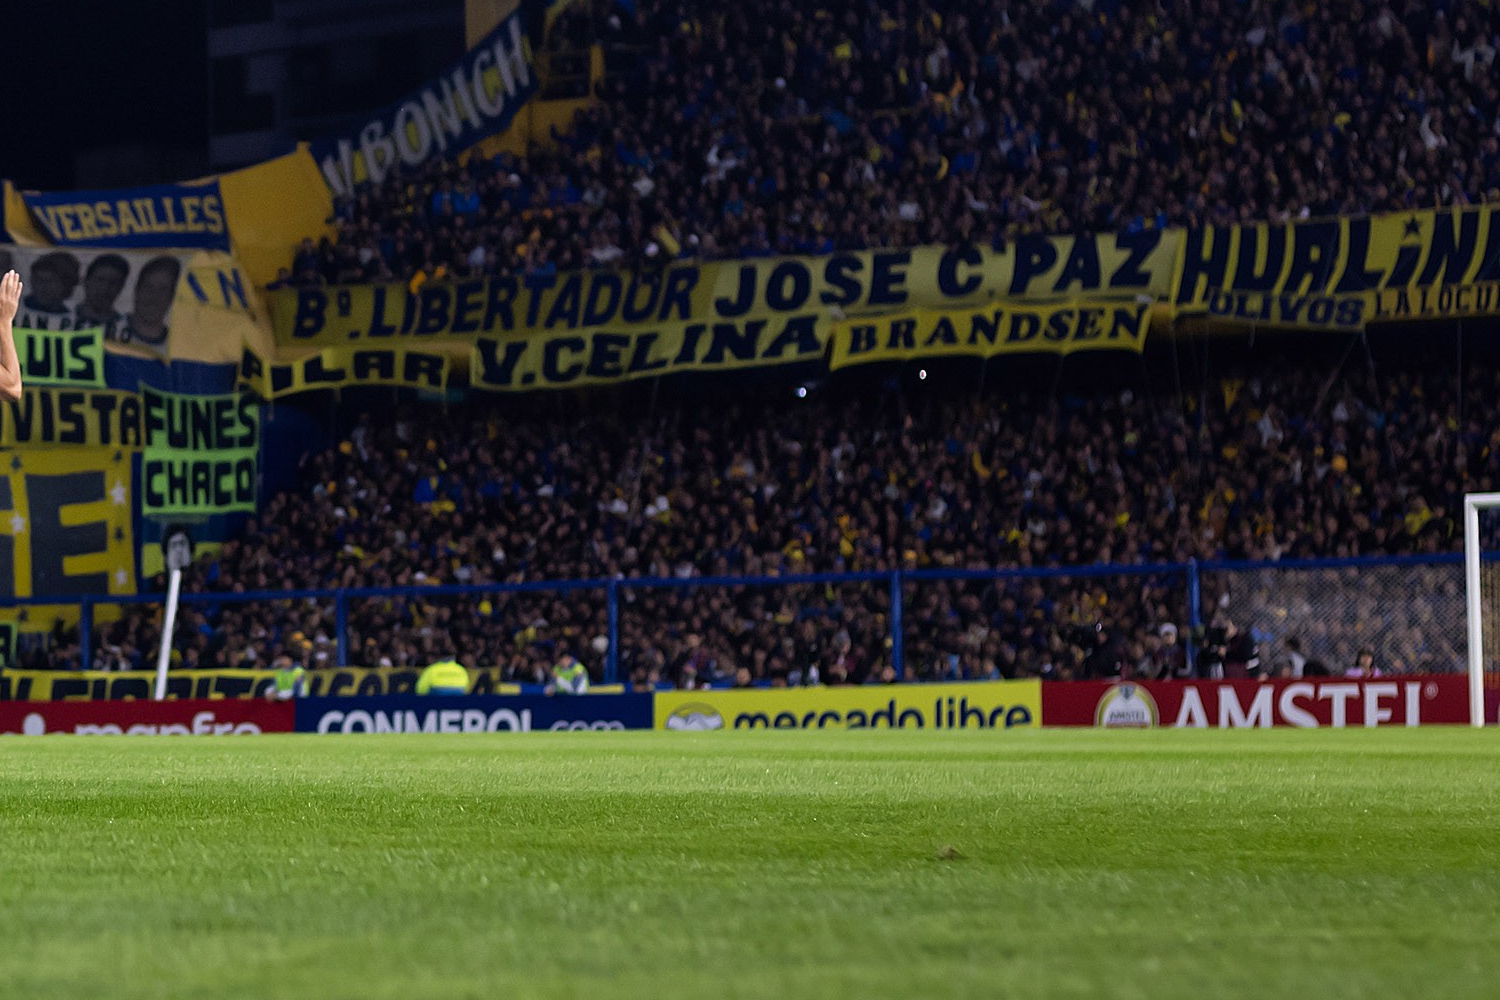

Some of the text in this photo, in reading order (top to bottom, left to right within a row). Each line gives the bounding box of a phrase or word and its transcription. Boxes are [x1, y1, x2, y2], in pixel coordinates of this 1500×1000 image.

[31, 194, 226, 242] VERSAILLES
[713, 246, 911, 317] JOSE
[1008, 229, 1162, 296] PAZ
[848, 306, 1150, 356] BRANDSEN
[22, 335, 96, 381] UIS
[146, 400, 255, 446] FUNES
[145, 460, 257, 507] CHACO
[734, 696, 1033, 730] mercado libre
